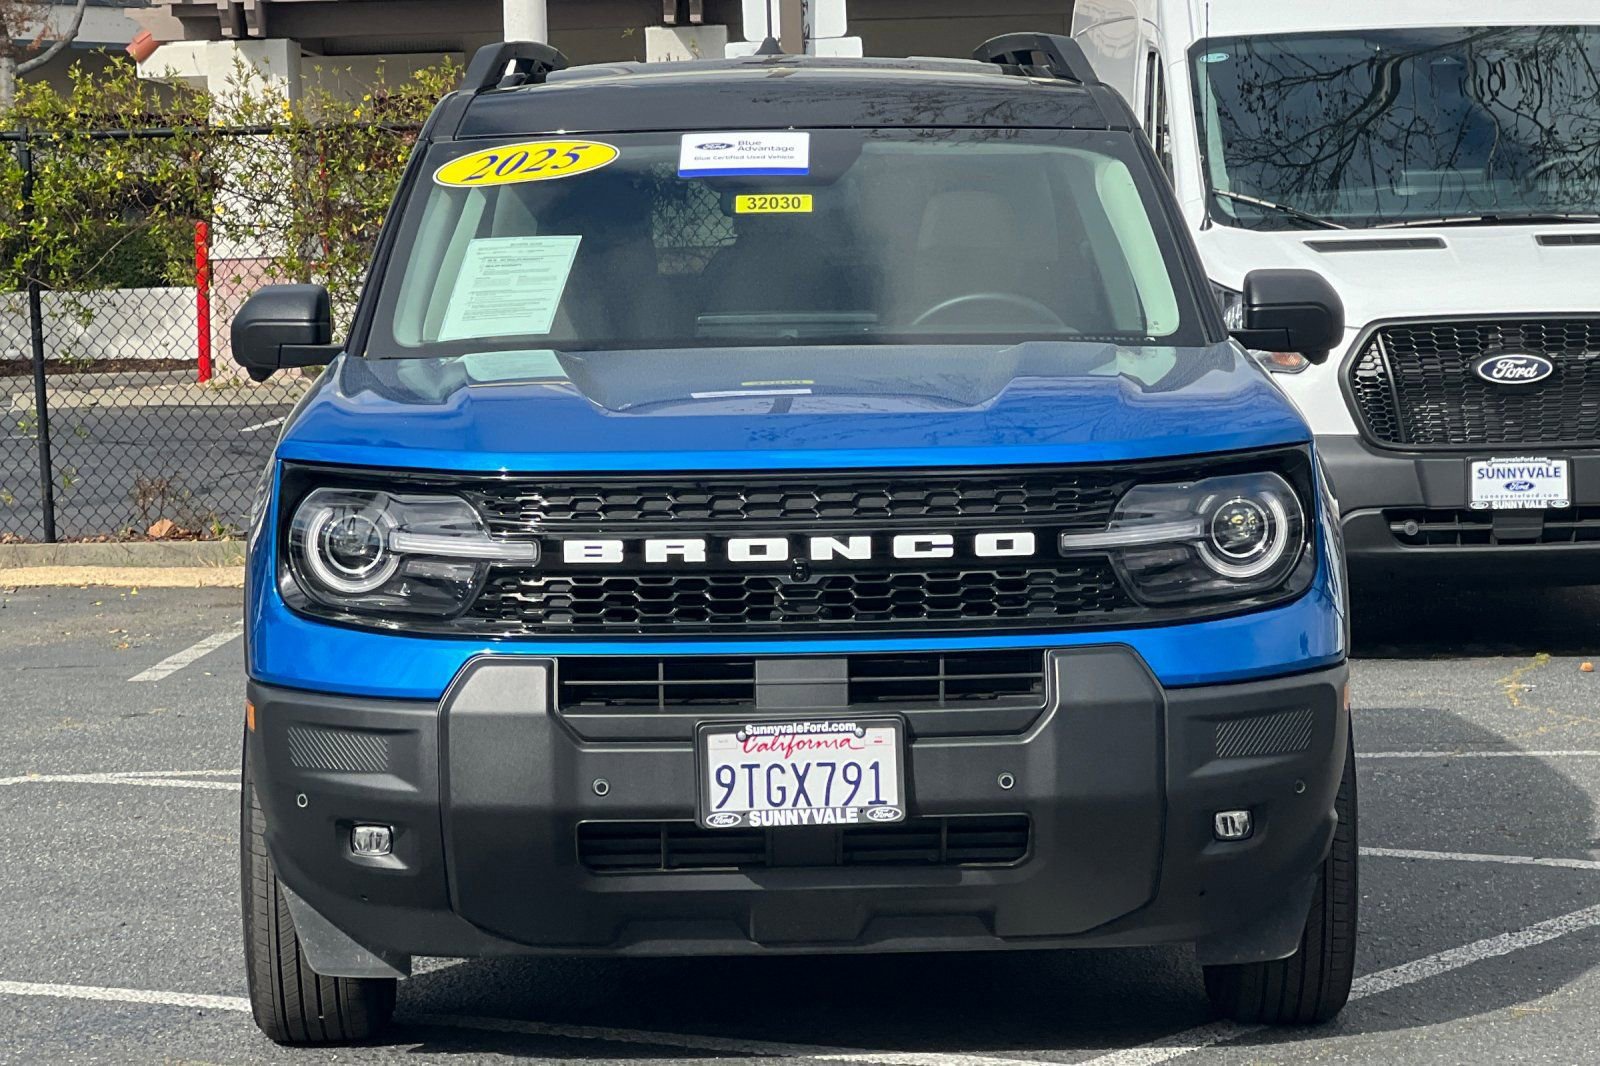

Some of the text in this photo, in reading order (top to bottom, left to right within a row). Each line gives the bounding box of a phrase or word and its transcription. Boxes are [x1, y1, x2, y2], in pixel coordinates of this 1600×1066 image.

[461, 145, 591, 183] 2025
[746, 196, 802, 210] 32030
[1492, 358, 1538, 379] Ford
[1477, 466, 1561, 479] SUNNYVALE
[1491, 500, 1548, 510] SUNNYVALE
[563, 532, 1036, 564] BRONCO
[745, 722, 856, 736] SunnyvaleFord.com
[742, 734, 864, 759] California
[715, 761, 888, 809] 9TGX791
[713, 808, 895, 827] Ford SUNNYVALE Ford
